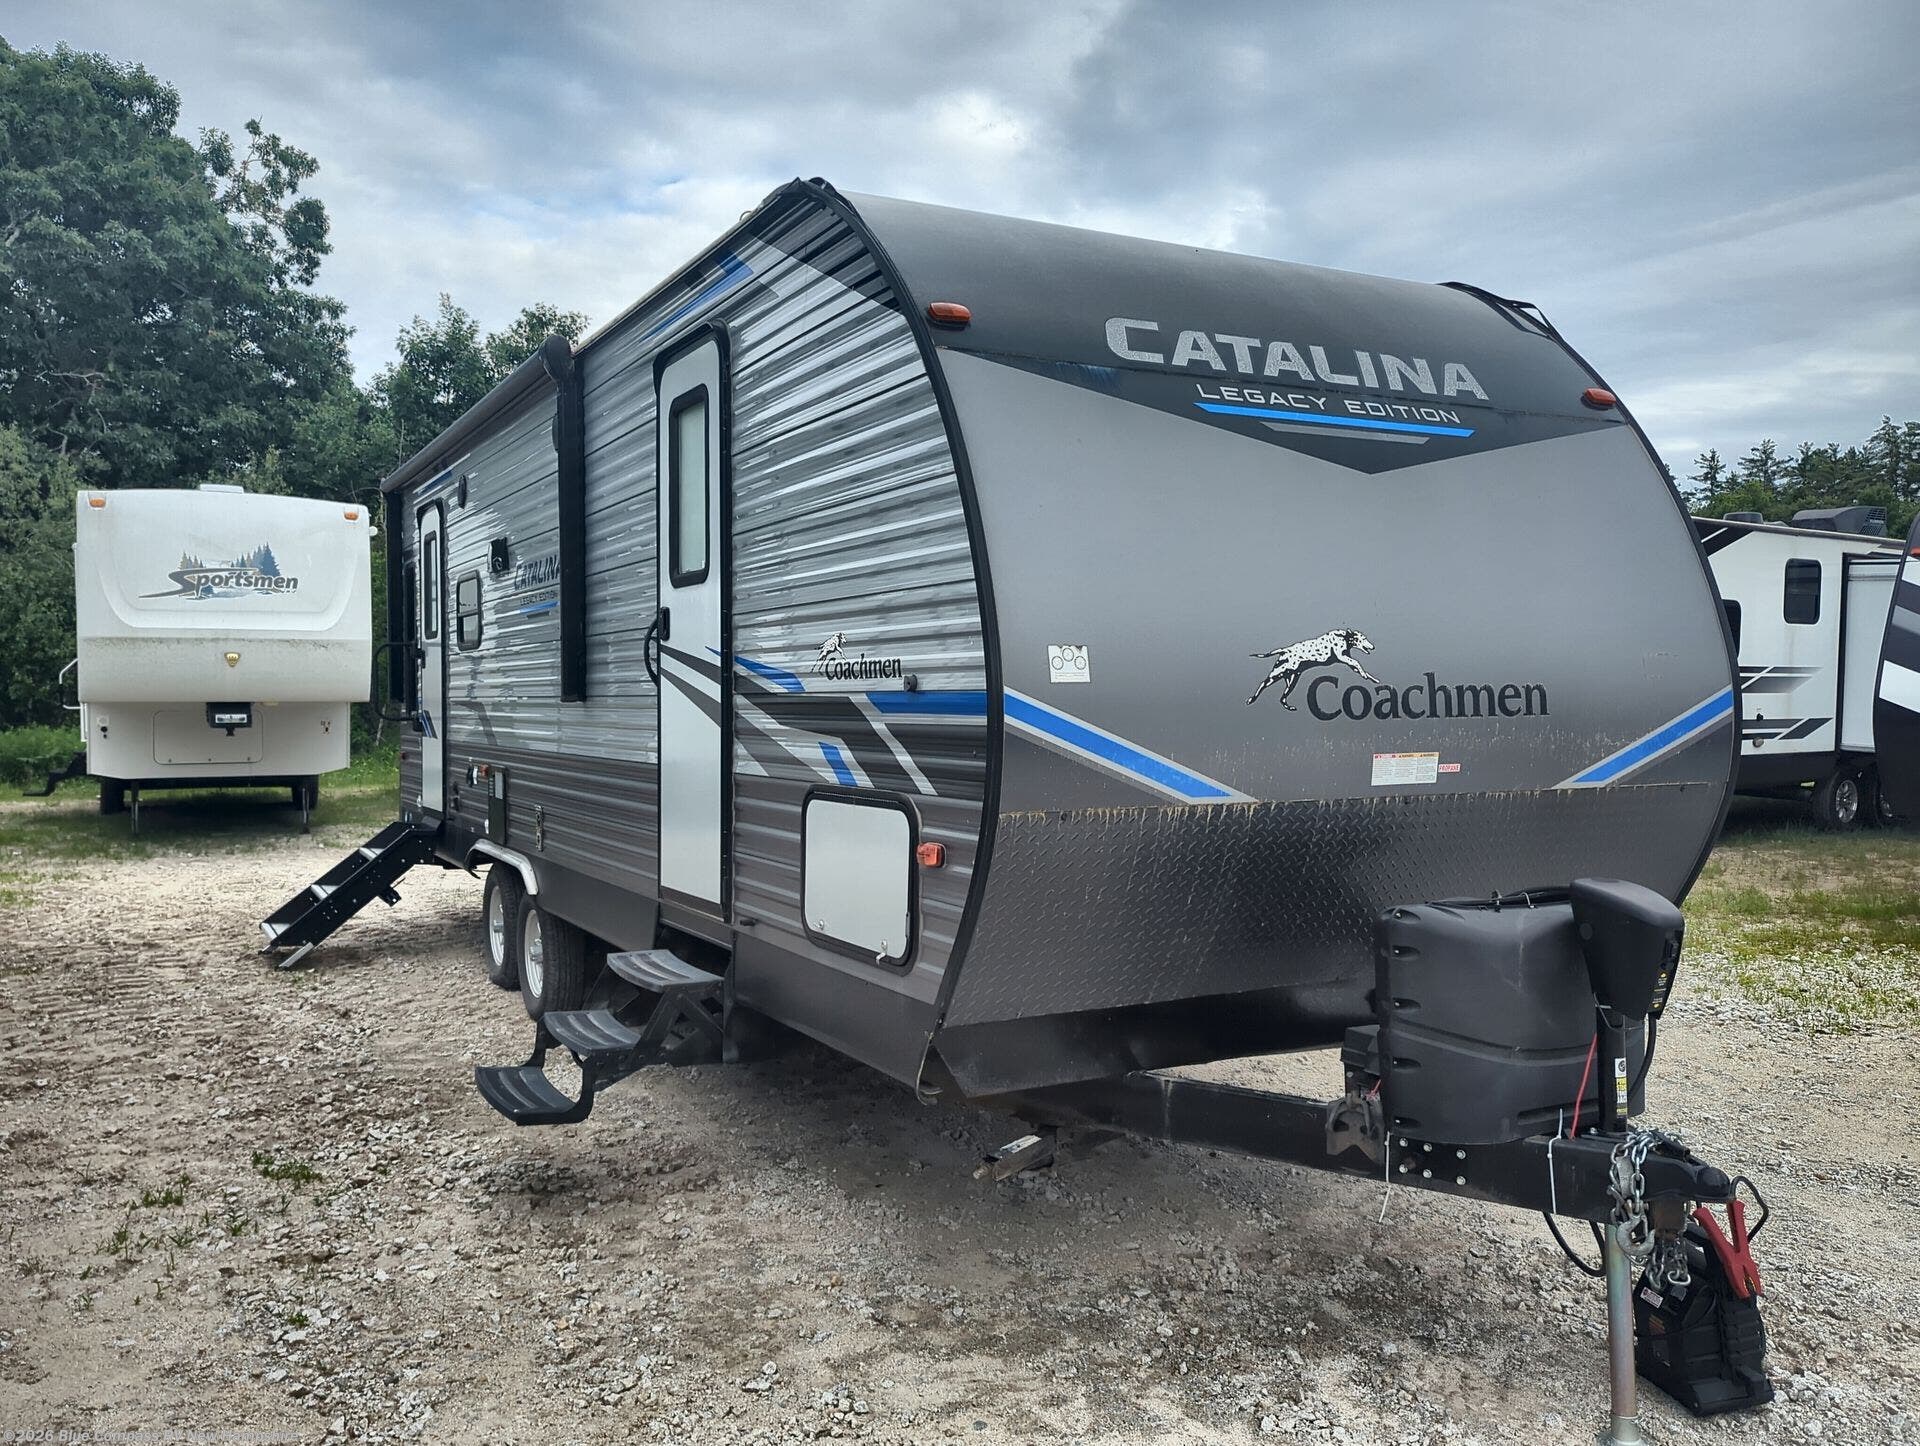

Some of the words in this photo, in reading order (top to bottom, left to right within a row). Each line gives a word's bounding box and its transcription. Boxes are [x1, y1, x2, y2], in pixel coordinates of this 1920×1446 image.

[1105, 317, 1490, 400] CATALINA
[1196, 384, 1327, 411] LEGACY
[1344, 400, 1461, 424] EDITION
[139, 567, 299, 598] Sportsmen
[825, 653, 903, 681] Coachmen
[1307, 672, 1550, 721] Coachmen
